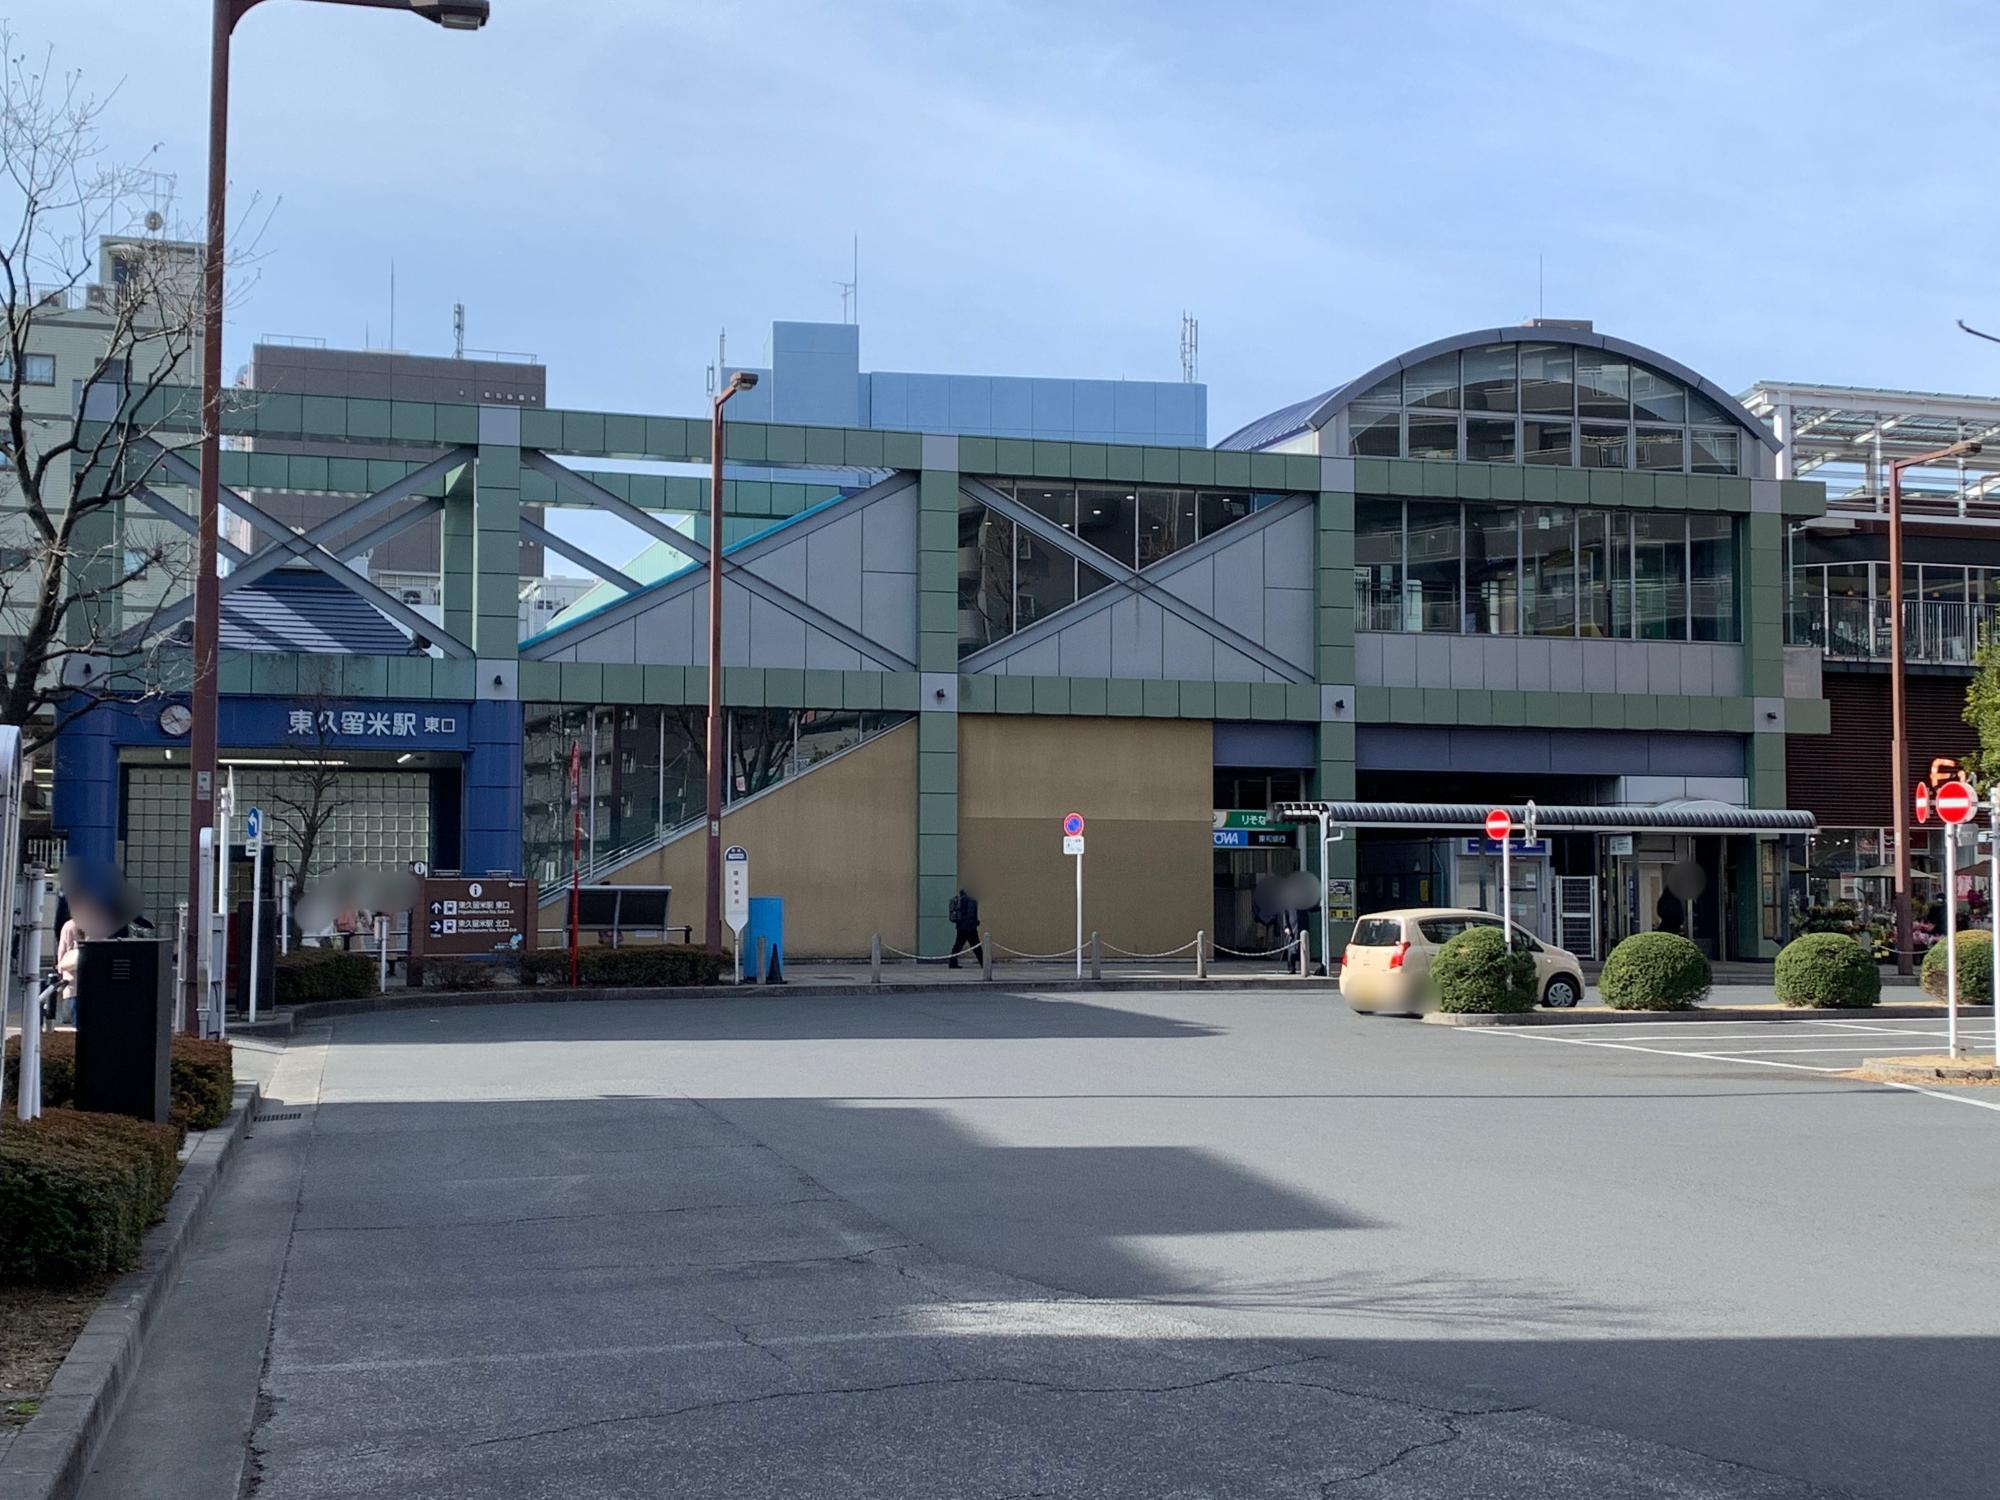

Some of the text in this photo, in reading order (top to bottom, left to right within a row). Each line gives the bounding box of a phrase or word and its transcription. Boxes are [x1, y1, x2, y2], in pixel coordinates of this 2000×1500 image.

[288, 711, 456, 736] 東久留米駅 東口
